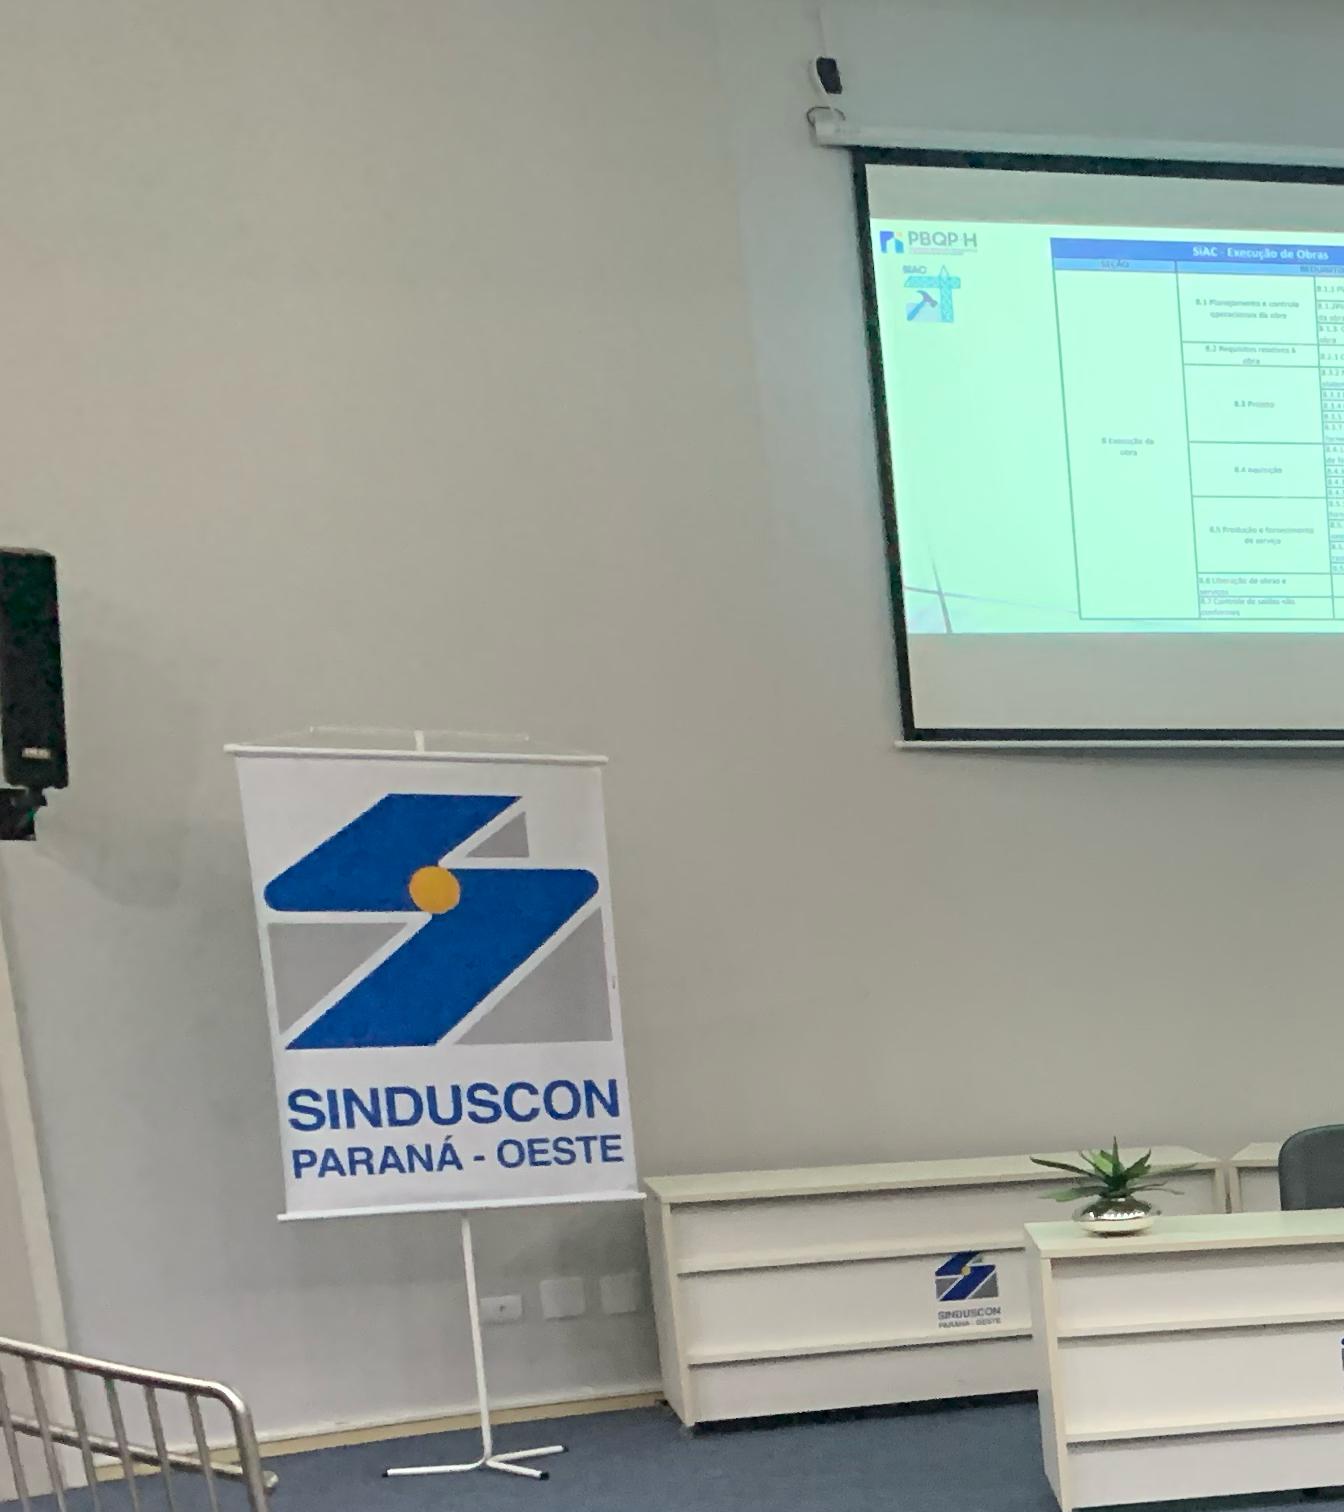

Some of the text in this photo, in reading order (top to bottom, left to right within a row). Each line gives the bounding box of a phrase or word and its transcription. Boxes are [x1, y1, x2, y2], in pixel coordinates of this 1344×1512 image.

[1227, 248, 1277, 260] Execução
[1280, 249, 1294, 259] de
[1296, 249, 1329, 260] Obras
[288, 1079, 620, 1132] SINDUSCON
[292, 1135, 463, 1179] PARANÁ
[497, 1134, 624, 1169] OESTE
